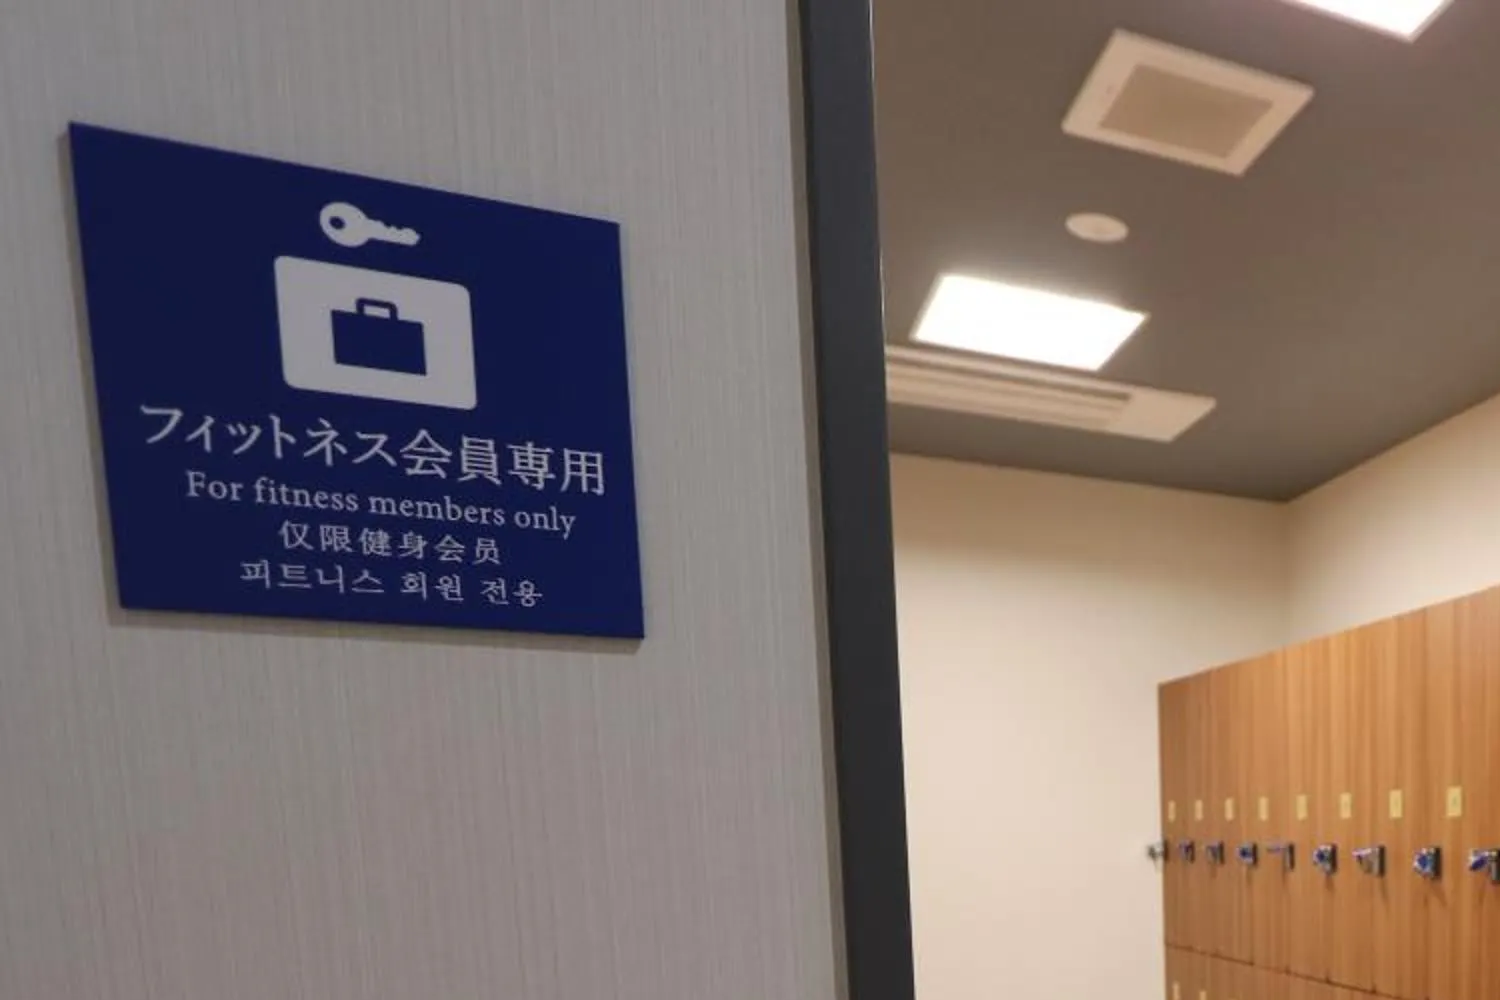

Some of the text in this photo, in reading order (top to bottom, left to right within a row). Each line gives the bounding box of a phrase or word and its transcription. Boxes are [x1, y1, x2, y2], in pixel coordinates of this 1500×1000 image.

[140, 405, 606, 496] フィットネス会員専用
[186, 471, 576, 540] For fitness members only
[280, 520, 500, 565] 仅限健身会员
[240, 559, 543, 607] 피트니스 회원 전용
